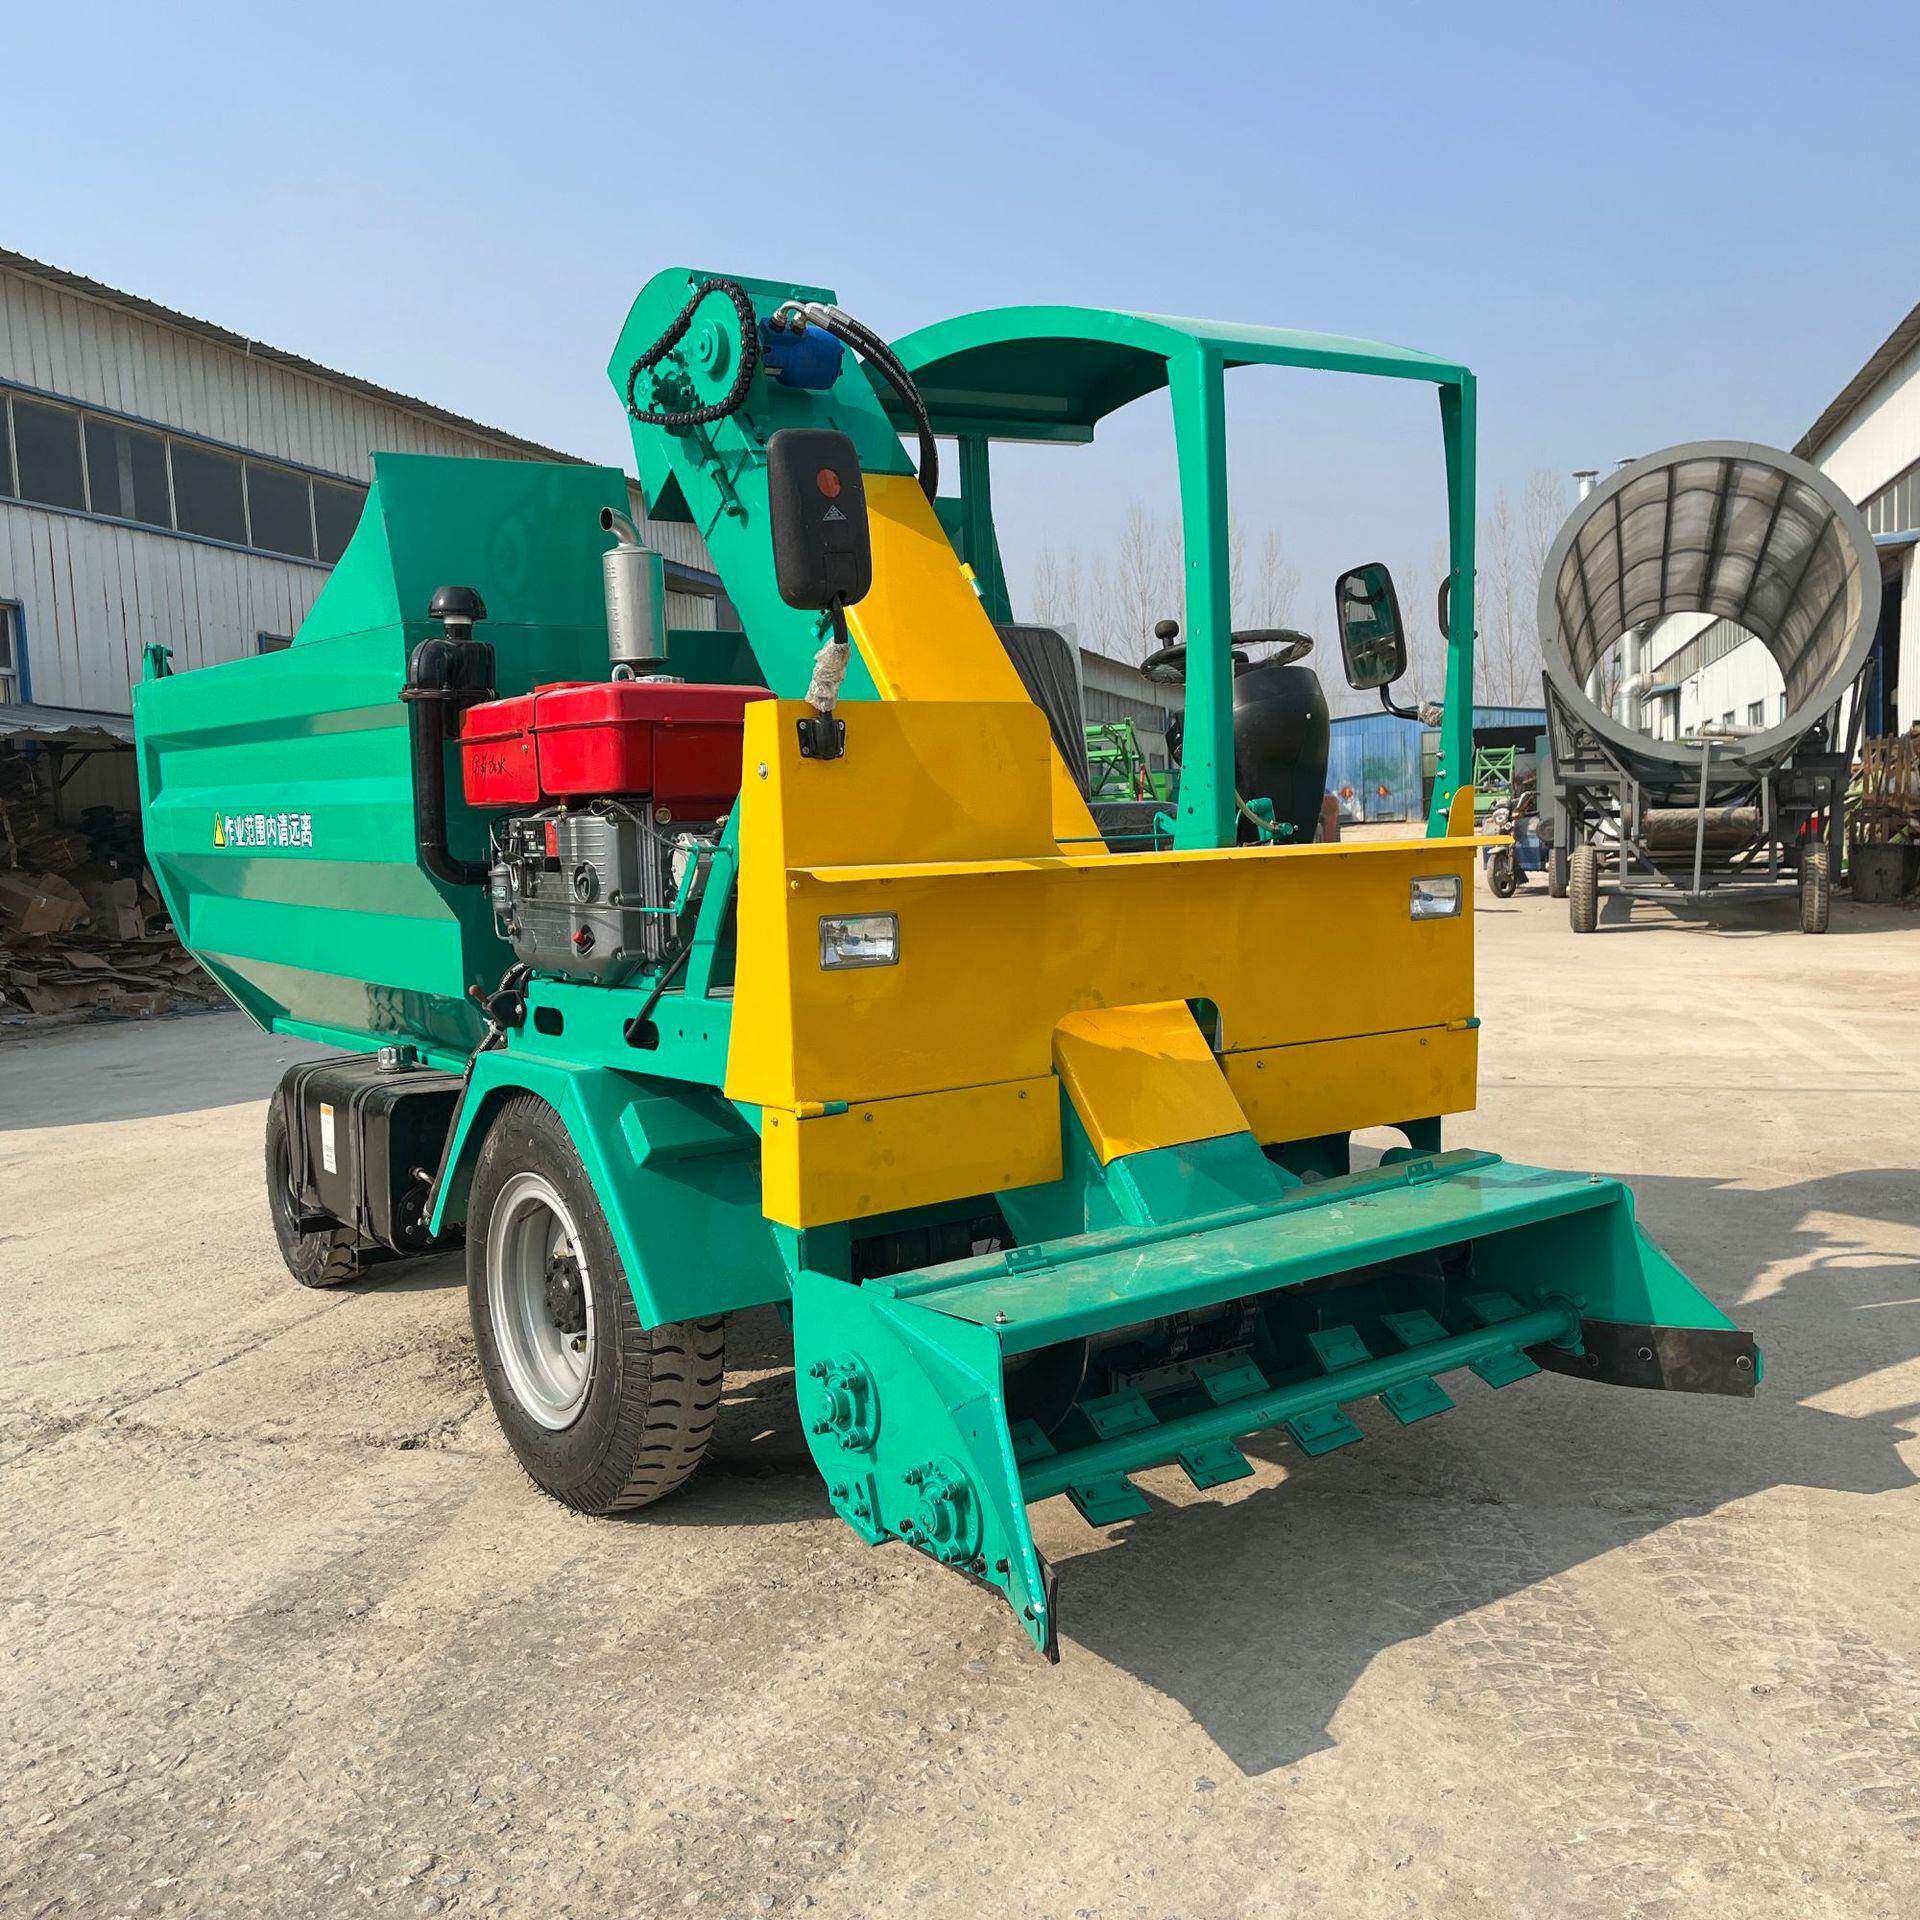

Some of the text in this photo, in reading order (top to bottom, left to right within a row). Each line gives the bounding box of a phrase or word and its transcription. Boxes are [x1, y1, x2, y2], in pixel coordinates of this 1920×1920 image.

[225, 813, 312, 847] 作业范围内请远离
